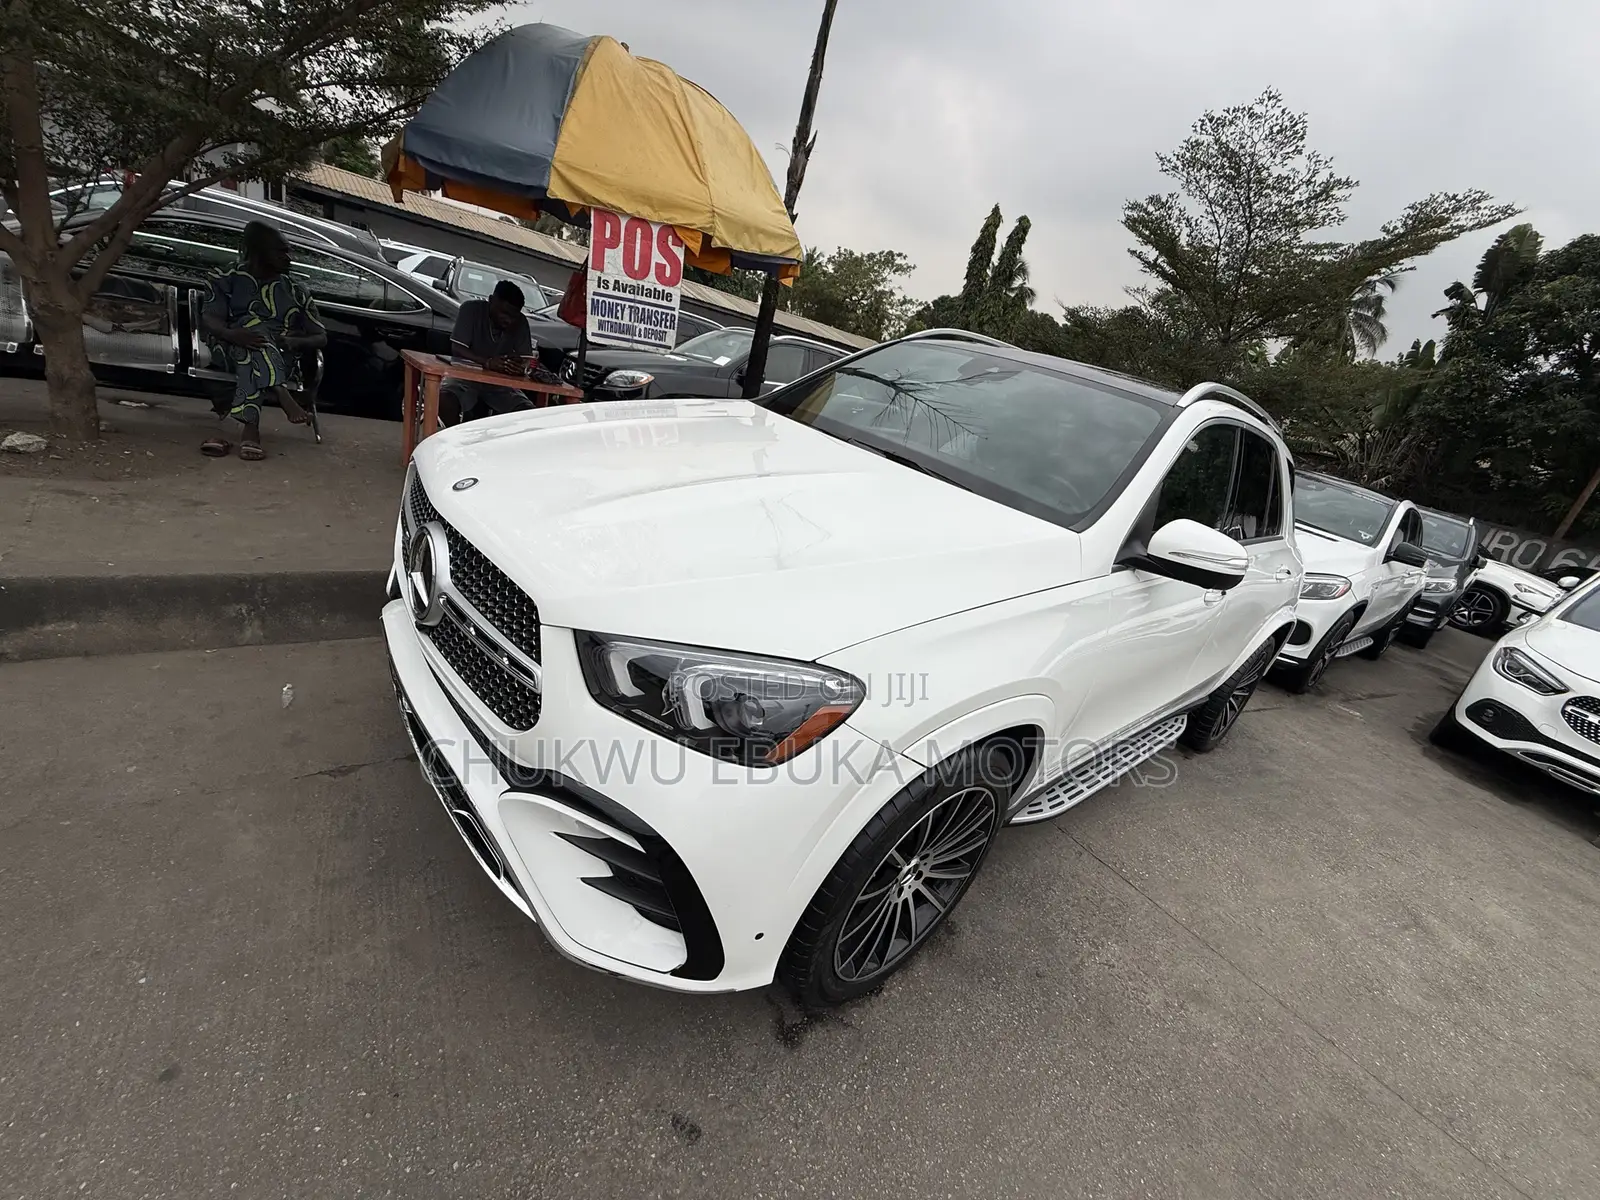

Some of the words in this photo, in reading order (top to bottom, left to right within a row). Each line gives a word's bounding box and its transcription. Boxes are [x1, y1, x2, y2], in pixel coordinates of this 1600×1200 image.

[591, 208, 684, 288] POS
[597, 276, 610, 290] Is
[612, 279, 673, 303] Available
[590, 298, 627, 321] MONEY
[627, 304, 677, 331] TRANSFER
[597, 318, 637, 337] WITHDRAWAL
[637, 327, 643, 338] &
[643, 326, 668, 343] DEPOSIT
